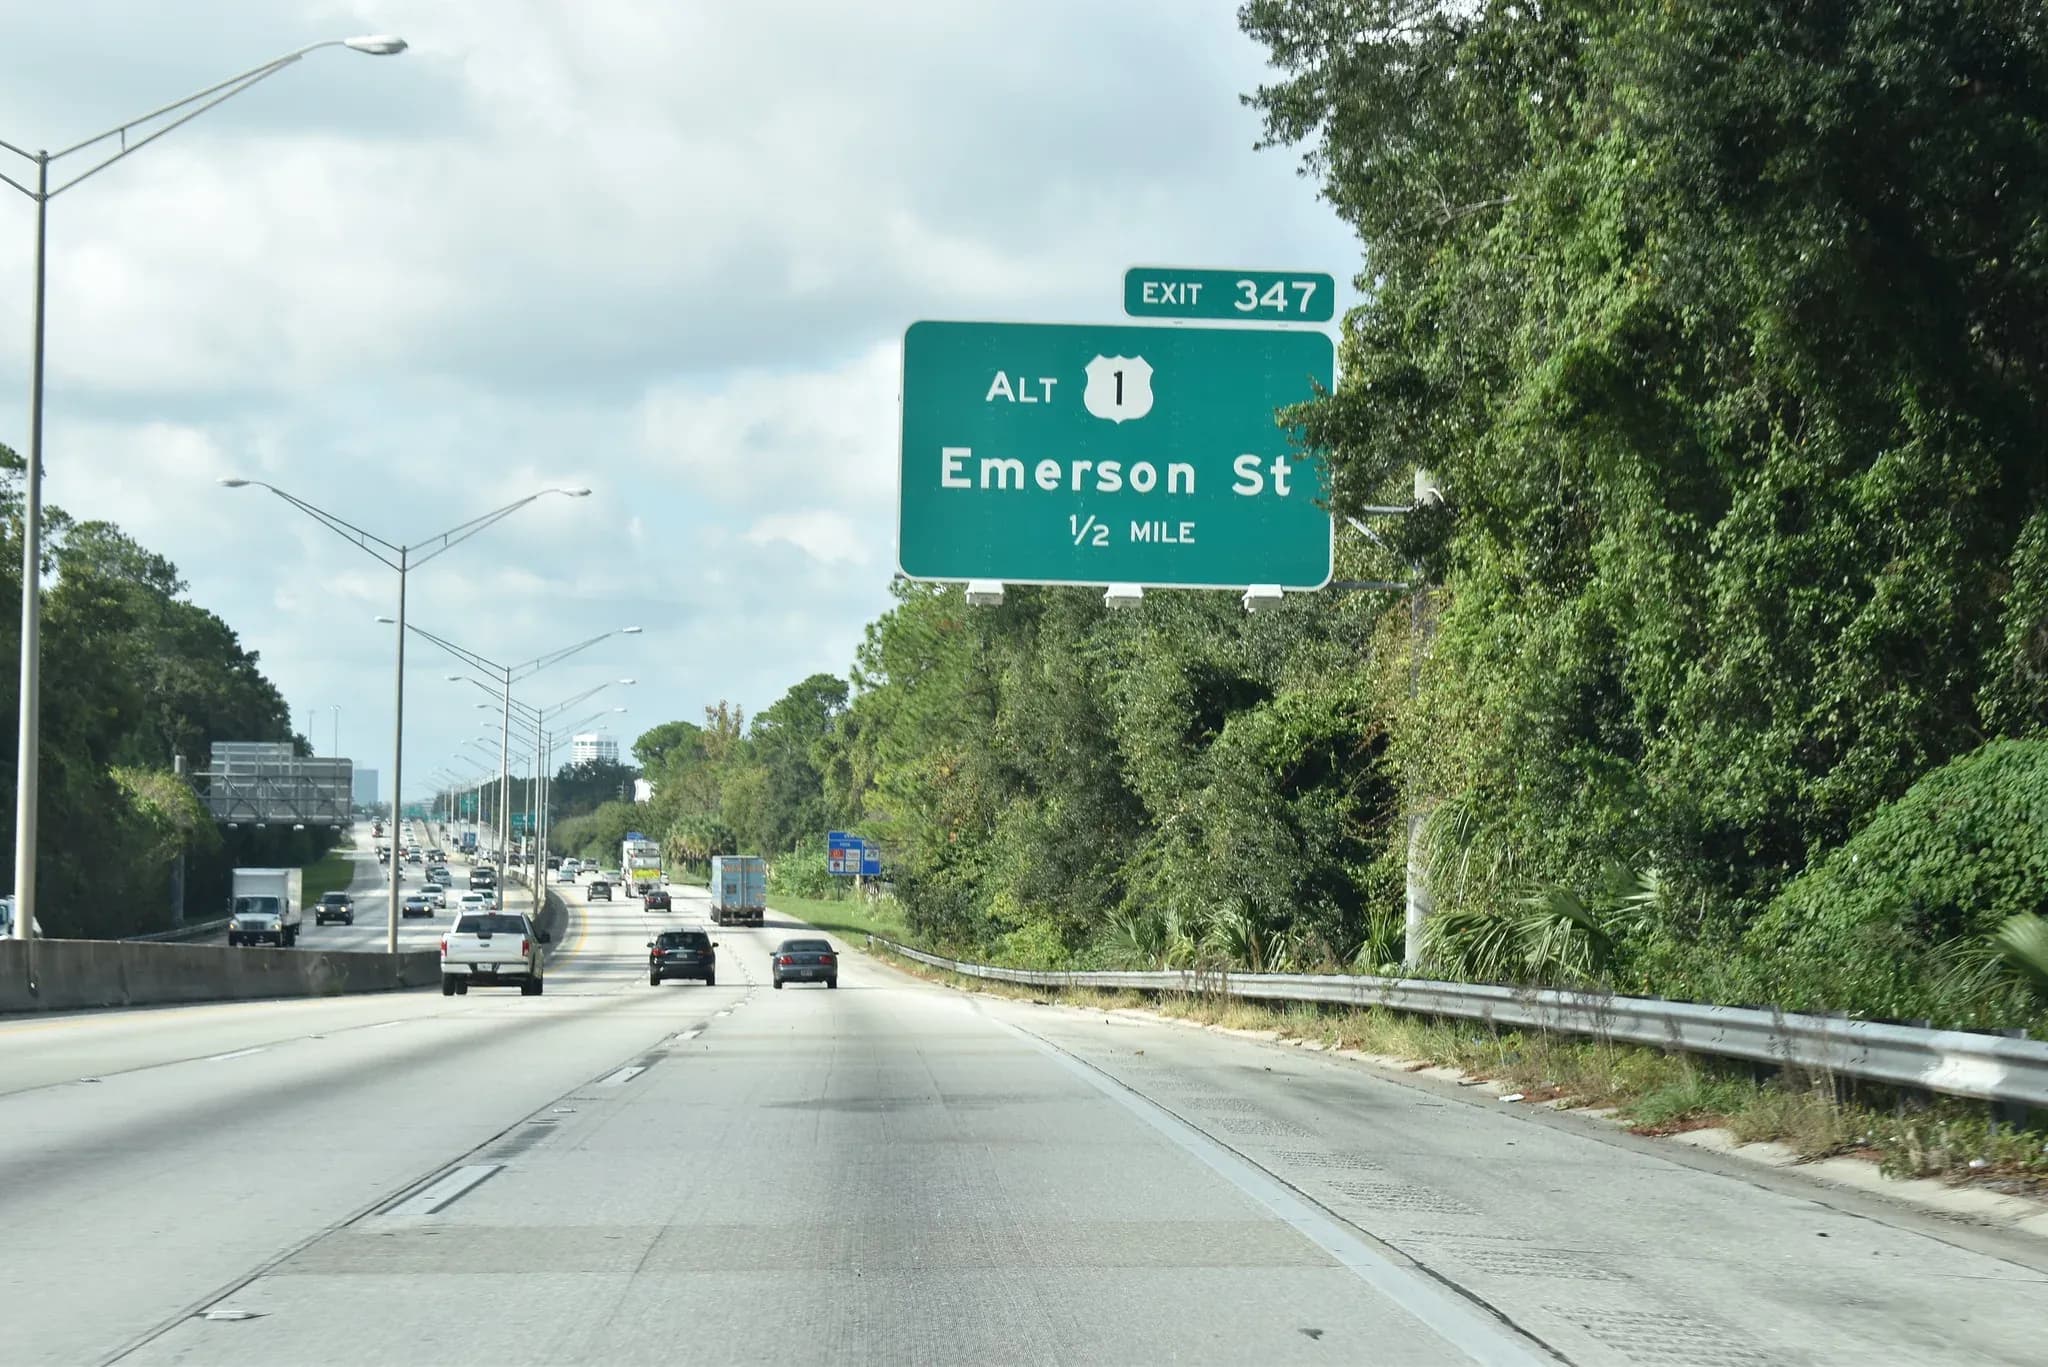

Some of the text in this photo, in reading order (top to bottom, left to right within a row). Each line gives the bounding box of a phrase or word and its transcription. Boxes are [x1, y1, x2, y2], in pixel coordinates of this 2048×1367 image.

[1143, 279, 1317, 313] EXIT 347
[985, 370, 1123, 406] ALT 1
[941, 446, 1292, 497] Emerson St
[1069, 514, 1195, 547] 1/2 MILE
